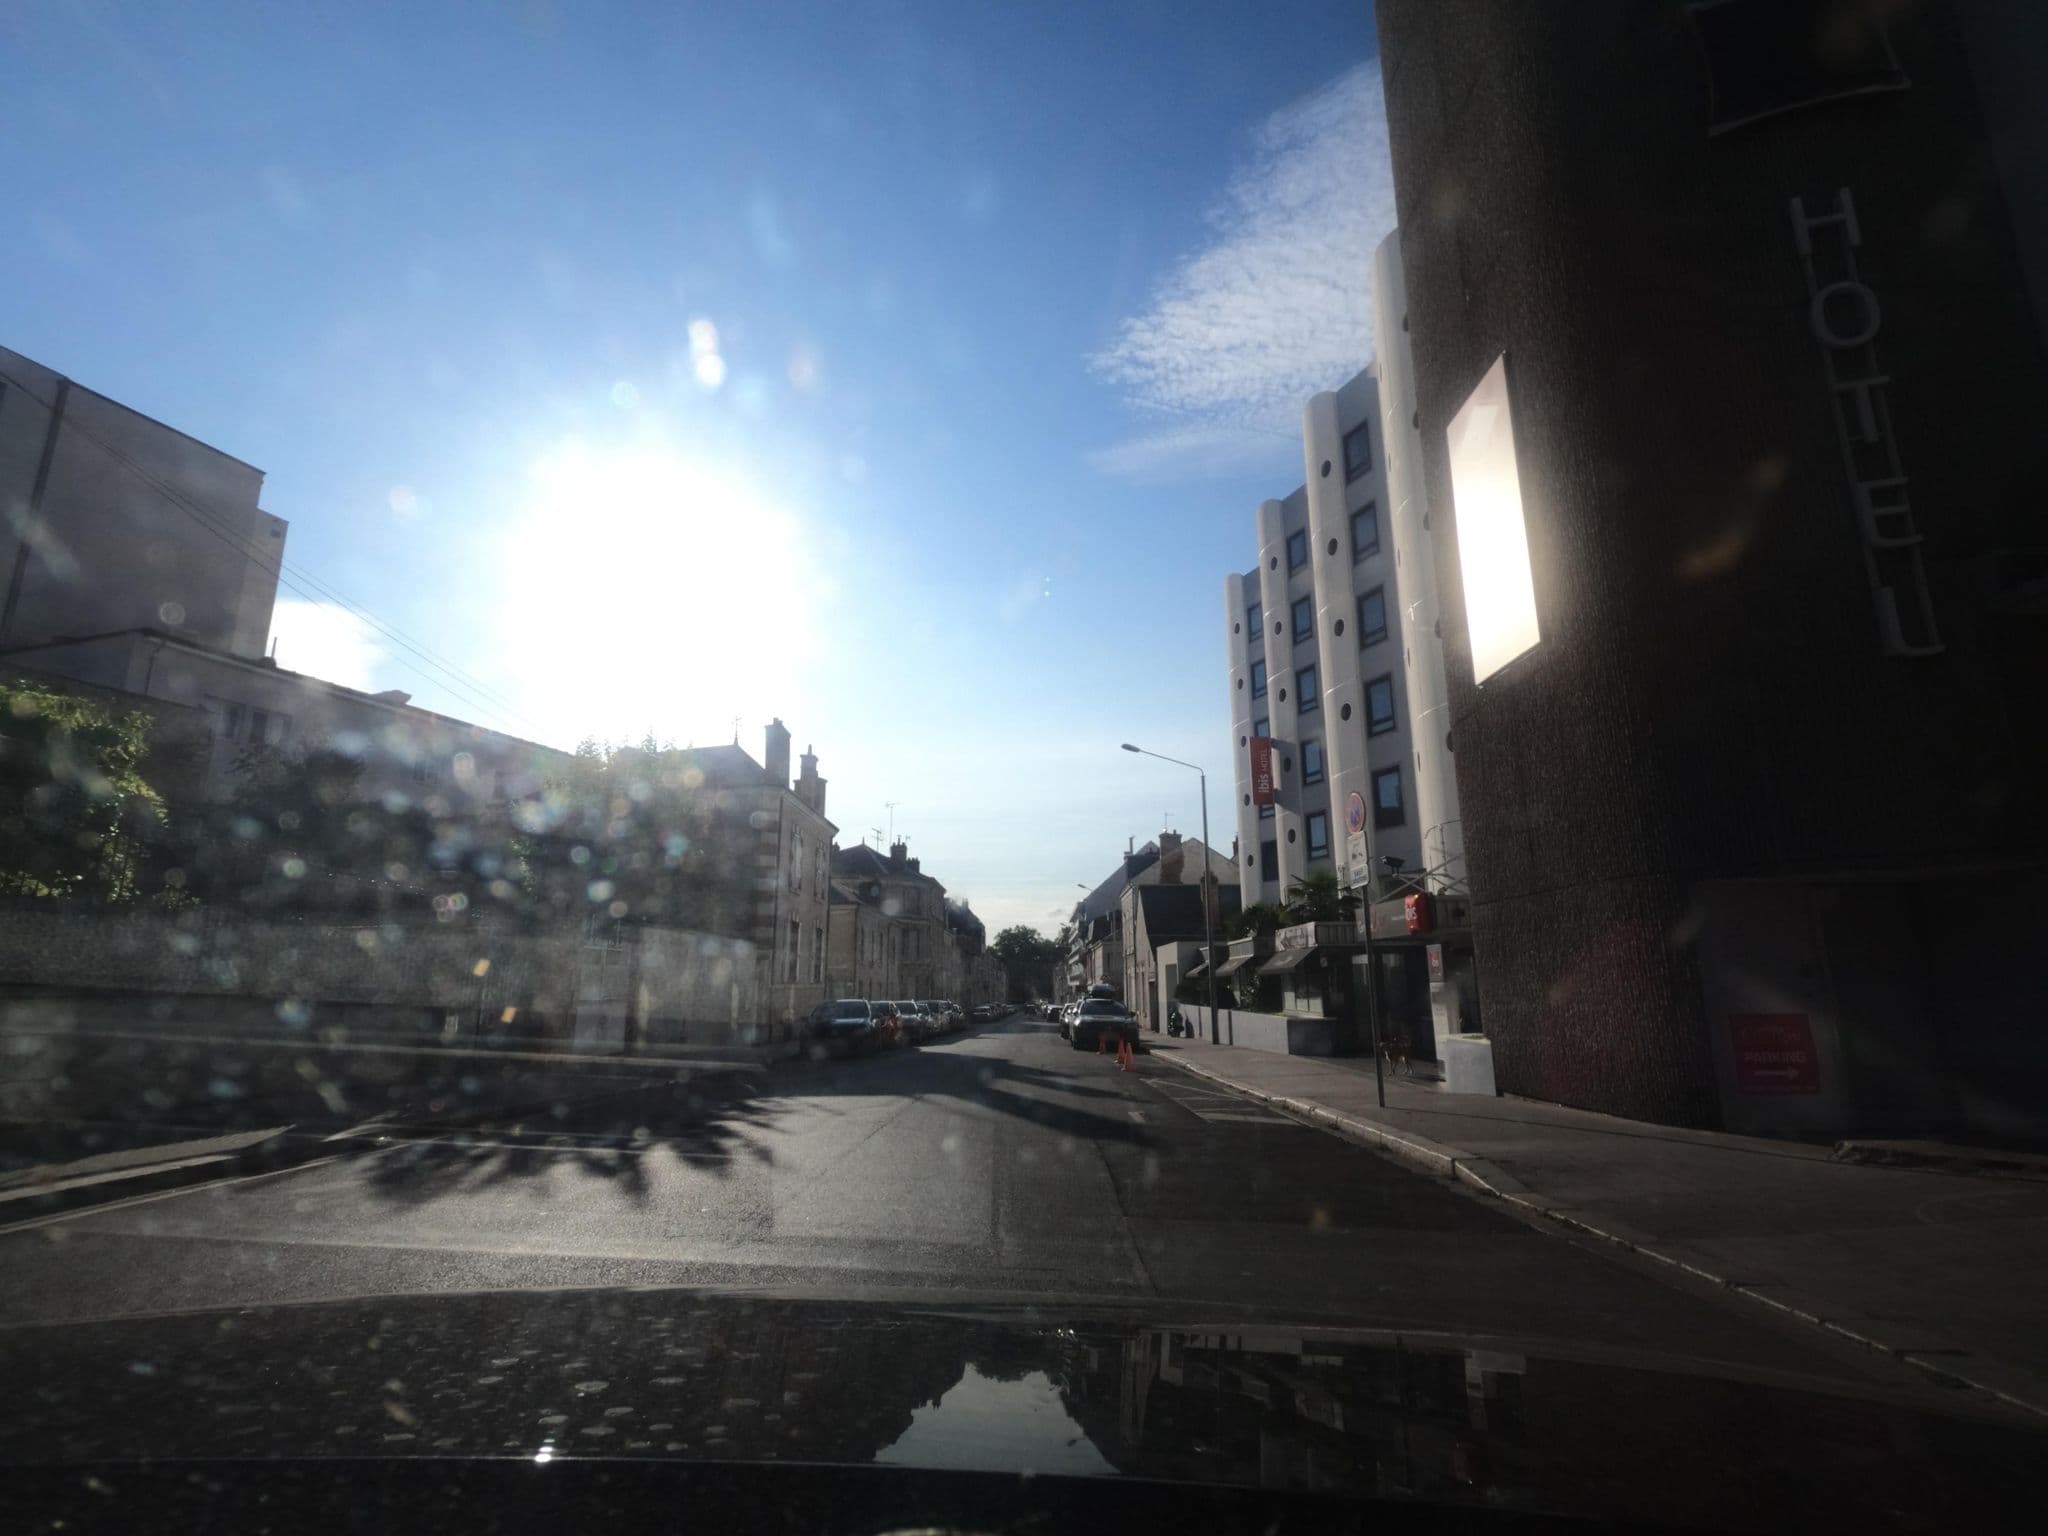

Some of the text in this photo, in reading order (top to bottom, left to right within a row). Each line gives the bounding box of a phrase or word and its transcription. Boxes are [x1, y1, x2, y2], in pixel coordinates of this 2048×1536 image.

[1789, 185, 1948, 658] HOTEL
[1257, 773, 1270, 793] ibis
[1743, 1050, 1808, 1065] PARKING
